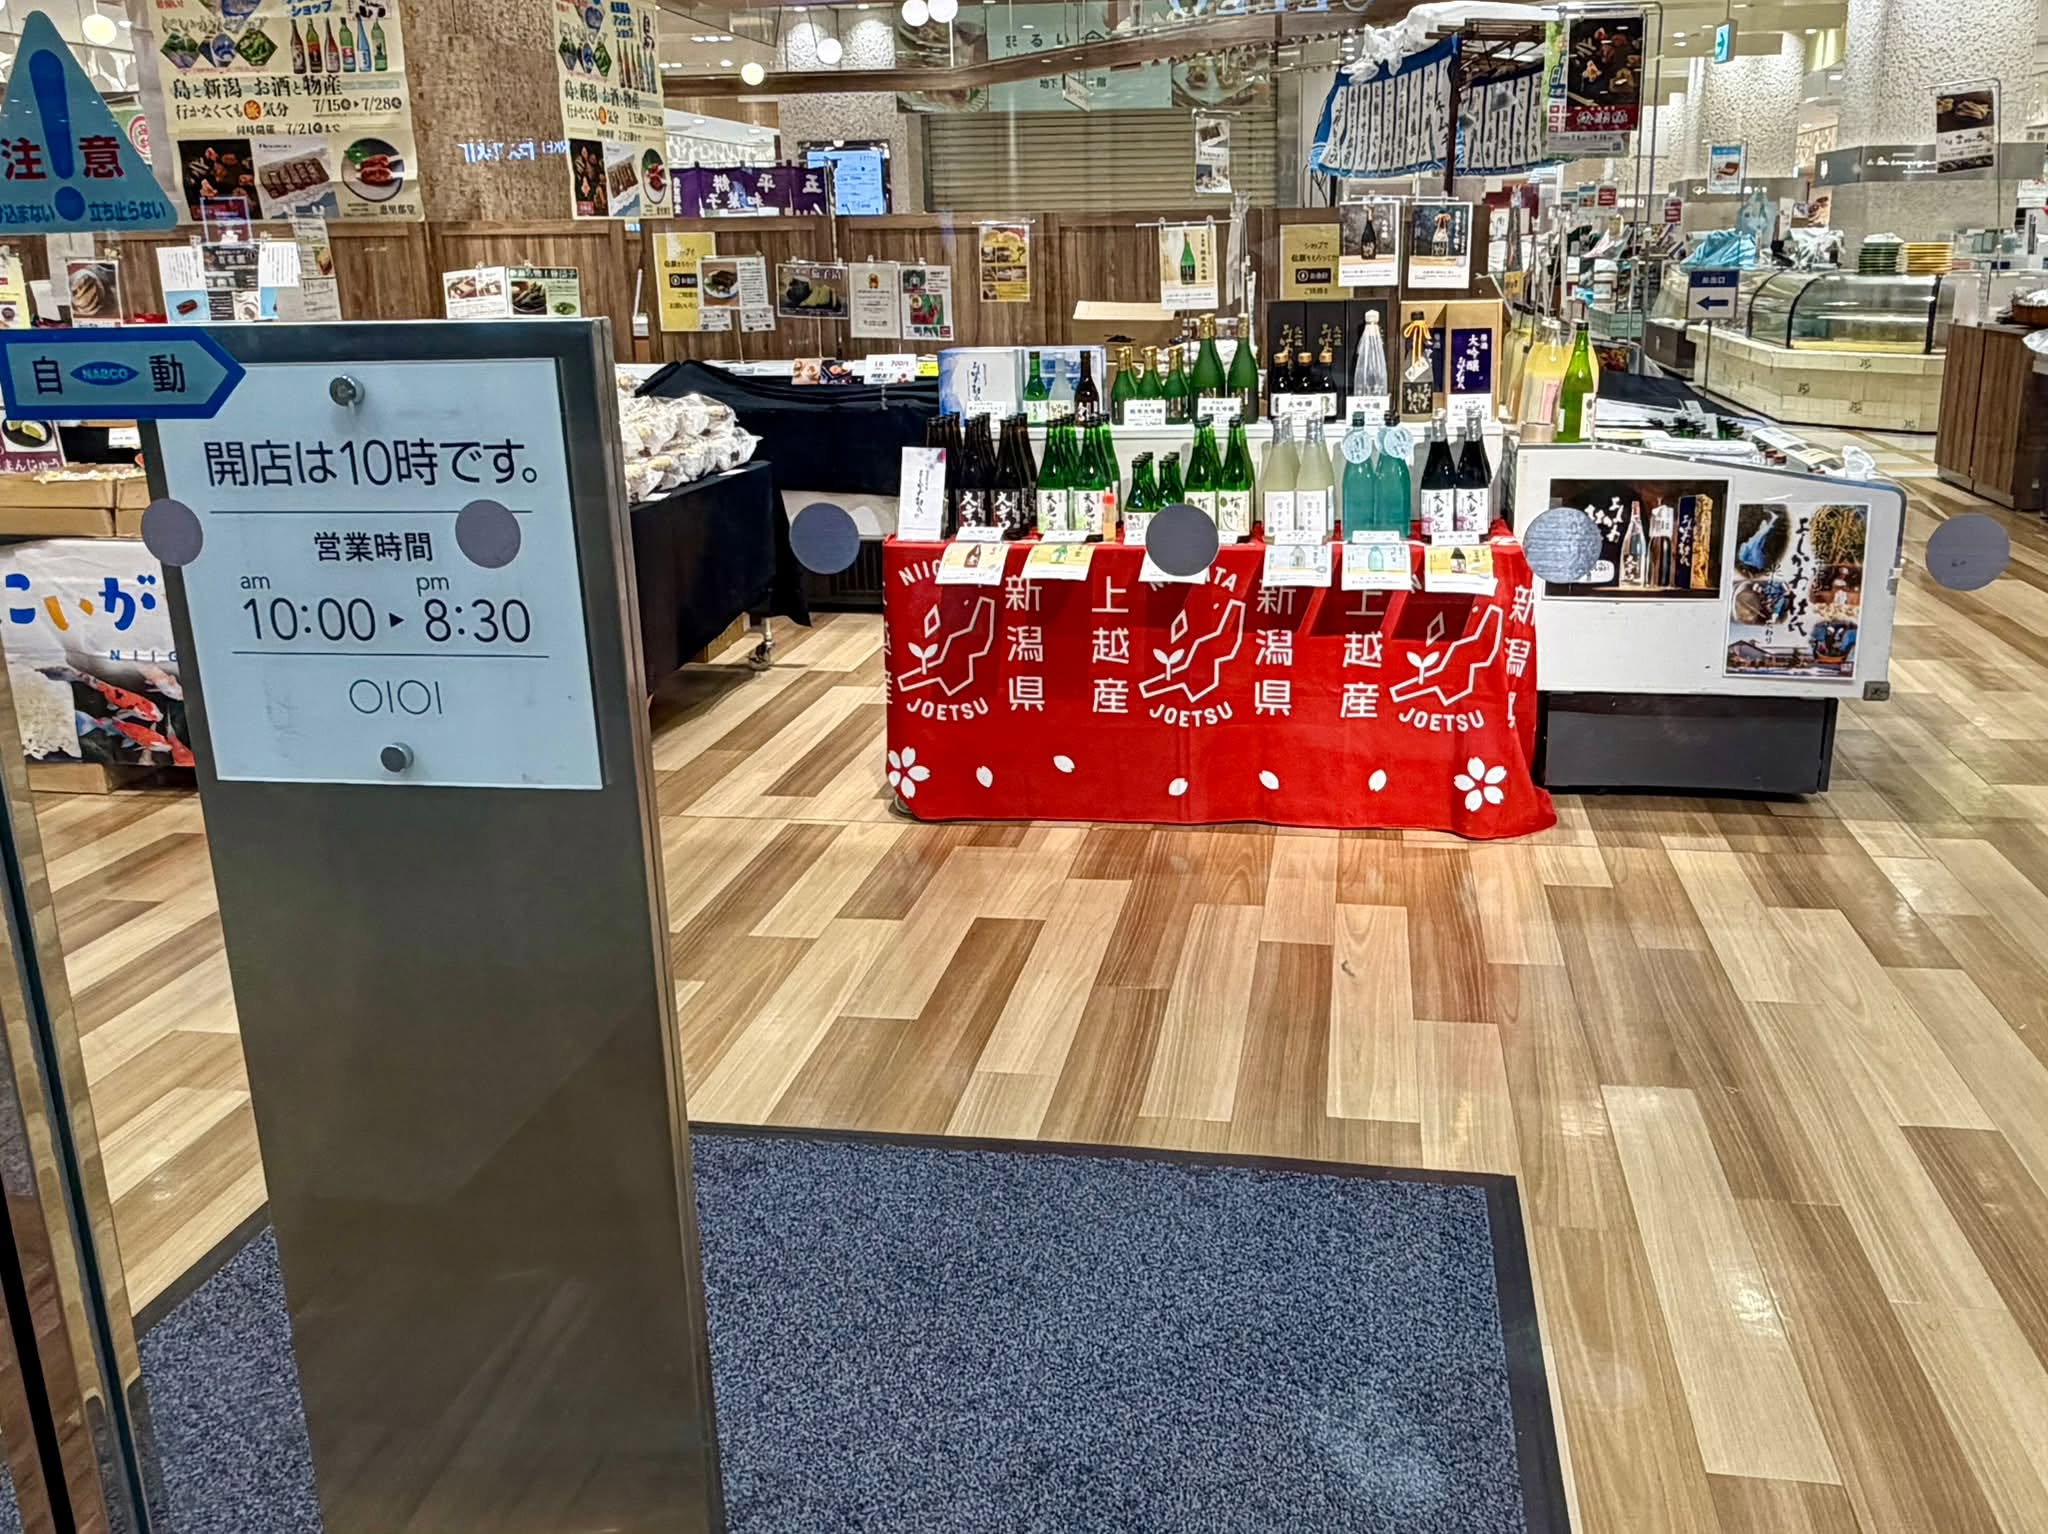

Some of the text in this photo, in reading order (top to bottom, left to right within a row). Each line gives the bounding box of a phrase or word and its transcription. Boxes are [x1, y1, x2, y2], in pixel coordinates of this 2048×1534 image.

[1466, 333, 1480, 373] 大吟醸
[204, 437, 539, 488] 開店は10時です。
[313, 531, 433, 563] 営業時間
[240, 573, 450, 597] am pm
[242, 597, 531, 643] 10:00 8:30
[1004, 574, 1046, 713] 新潟県
[1091, 575, 1130, 714] 上越産
[905, 697, 990, 722] JOETSU
[1149, 701, 1234, 728] JOETSU
[1398, 706, 1485, 732] JOETSU
